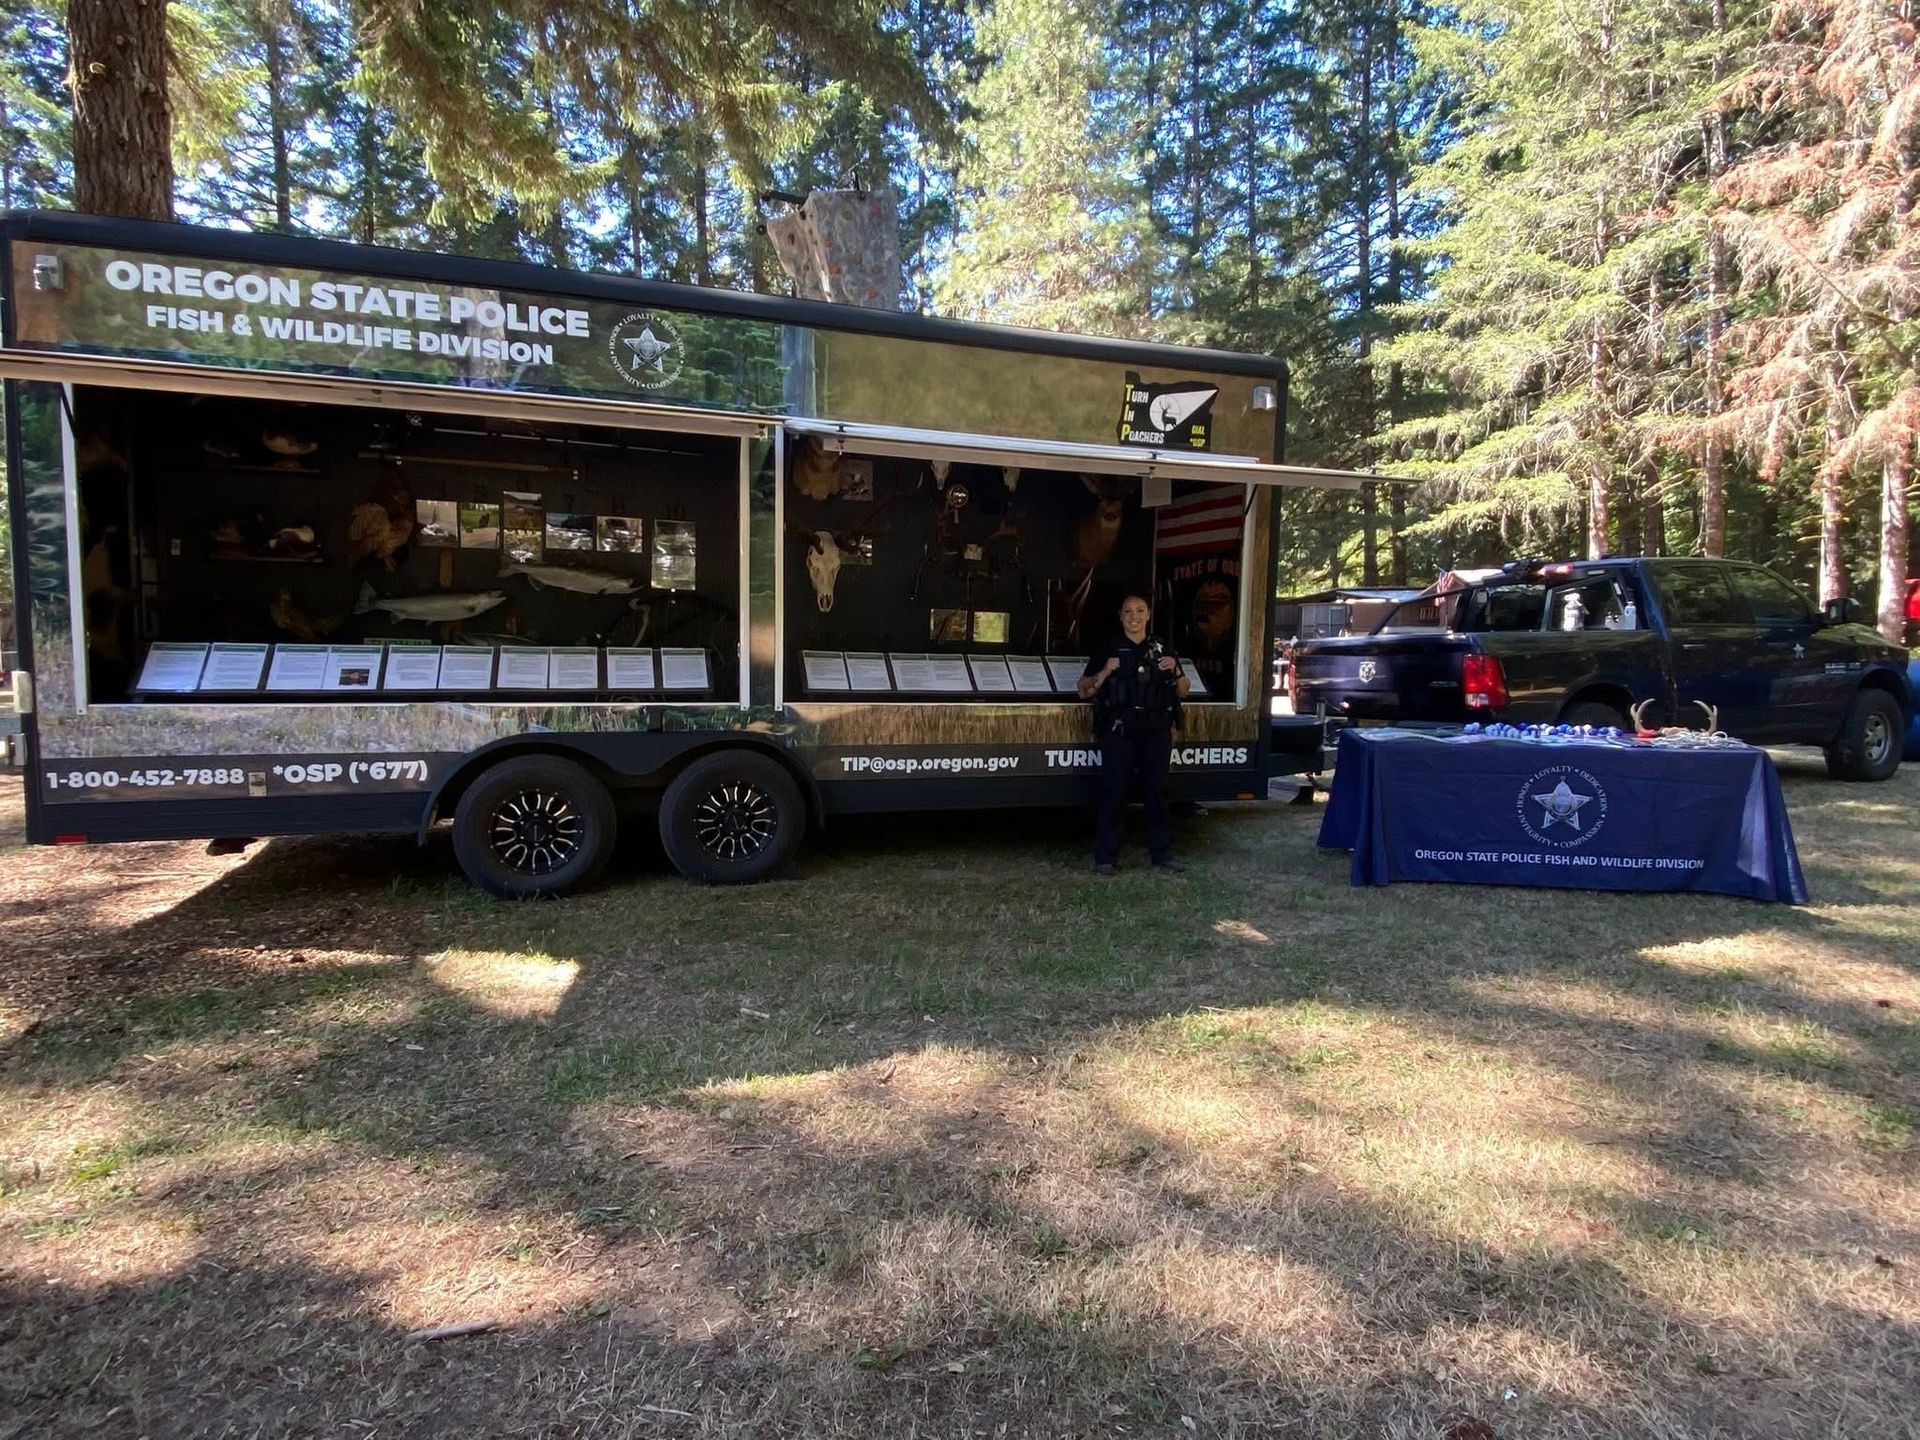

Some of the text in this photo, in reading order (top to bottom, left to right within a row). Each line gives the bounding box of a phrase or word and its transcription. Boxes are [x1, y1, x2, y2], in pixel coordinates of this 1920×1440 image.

[105, 260, 590, 338] OREGON STATE POLICE
[622, 312, 656, 325] LOYALTY
[147, 304, 554, 365] FISH & WILDLIFE DIVISION
[1125, 384, 1149, 403] TURN
[1121, 424, 1165, 445] POACHERS
[841, 755, 1019, 773] TIP@osp.oregon.gov
[1044, 749, 1102, 767] TURN
[46, 768, 245, 789] 1-800-452-7888
[1534, 765, 1574, 780] LOYALTY
[1579, 770, 1608, 812] DEDICATION
[1518, 814, 1552, 846] INTEGRITY
[1415, 849, 1704, 870] OREGON STATE POLICE FISH AND WILDLIFE DIVISION
